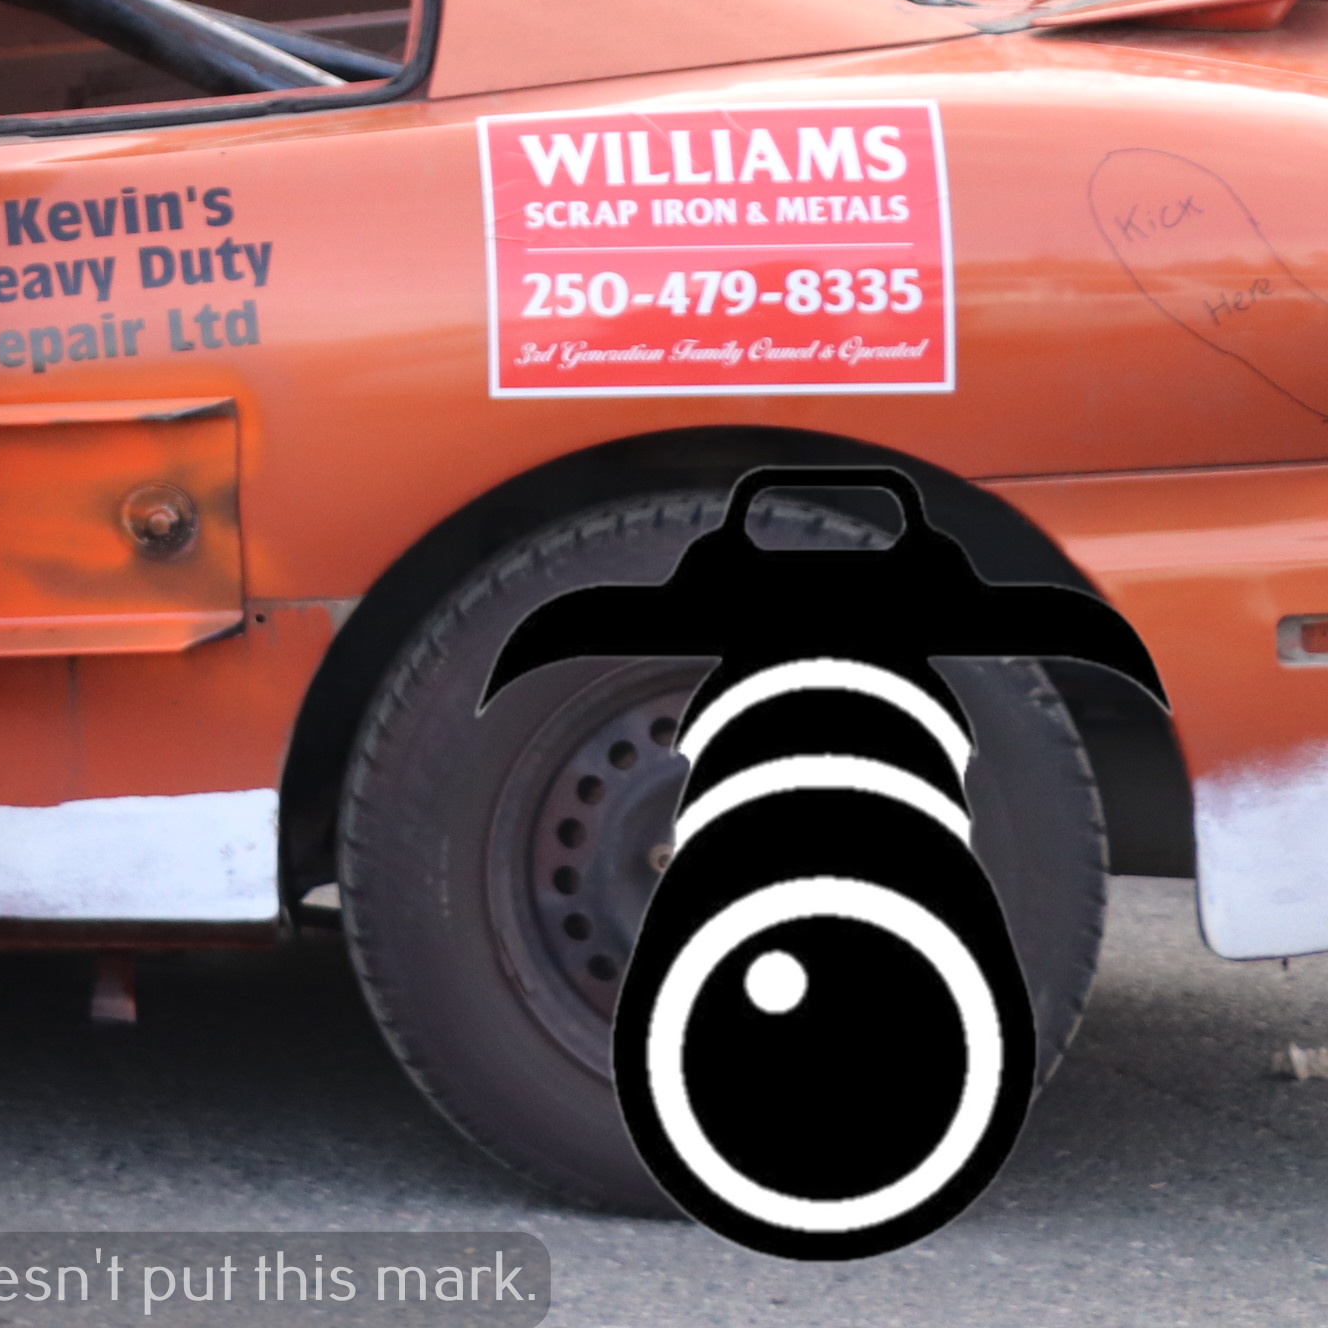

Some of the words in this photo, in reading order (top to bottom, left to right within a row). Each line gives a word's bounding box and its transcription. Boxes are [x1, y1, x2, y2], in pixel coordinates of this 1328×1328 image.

[519, 125, 908, 186] WILLIAMS
[4, 186, 235, 246] Kevin's
[525, 201, 638, 229] SCRAP
[651, 198, 737, 225] IRON
[746, 201, 769, 224] &
[776, 196, 909, 223] METALS
[139, 237, 273, 289] Duty
[521, 269, 923, 317] 250-479-8335
[168, 299, 260, 352] Ltd
[514, 341, 557, 366] 3rd
[557, 340, 665, 370] Generation
[667, 338, 743, 366] Family
[748, 336, 819, 362] Owned
[819, 343, 836, 361] &
[837, 335, 930, 364] Operated
